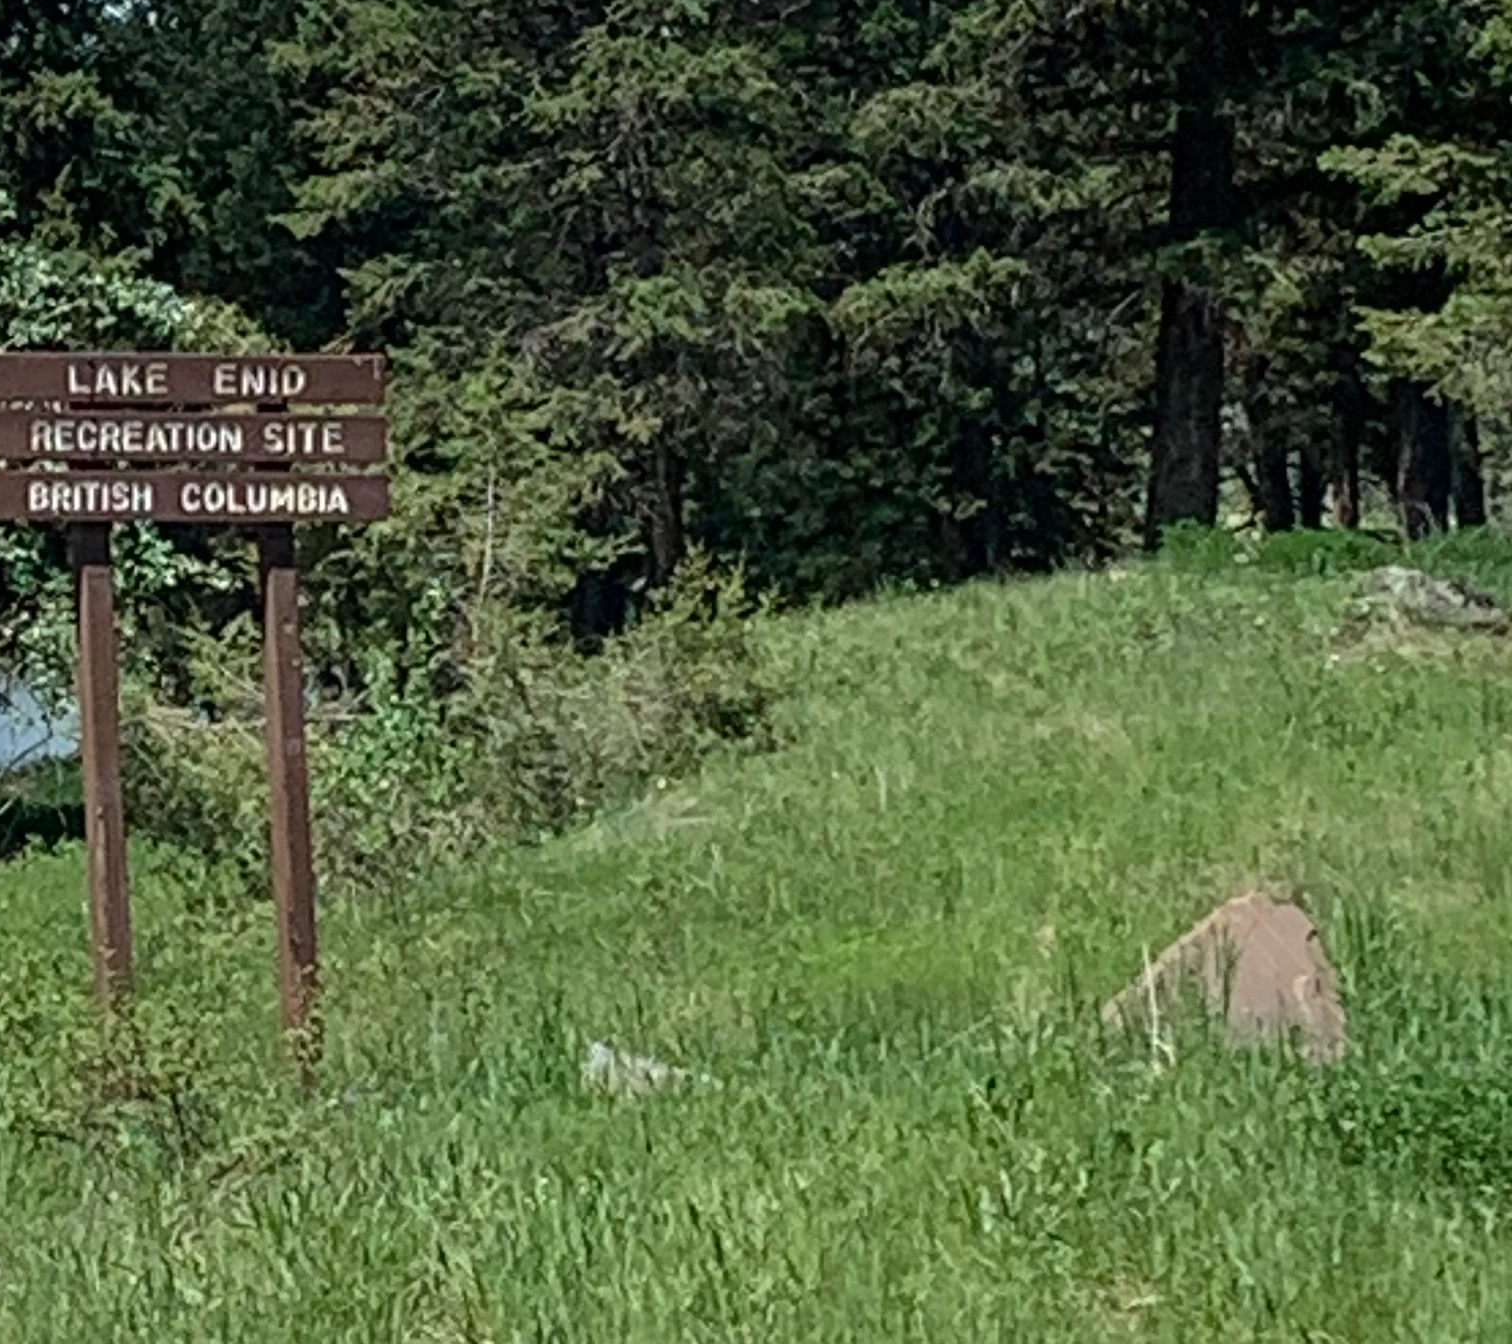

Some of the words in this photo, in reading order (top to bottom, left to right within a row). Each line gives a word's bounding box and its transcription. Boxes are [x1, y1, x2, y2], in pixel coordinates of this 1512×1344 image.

[67, 363, 169, 396] LAKE
[212, 363, 307, 396] ENID
[29, 419, 243, 453] RECREATION
[262, 421, 345, 455] SITE
[28, 481, 153, 513] BRITISH
[180, 483, 349, 515] COLUMBIA
